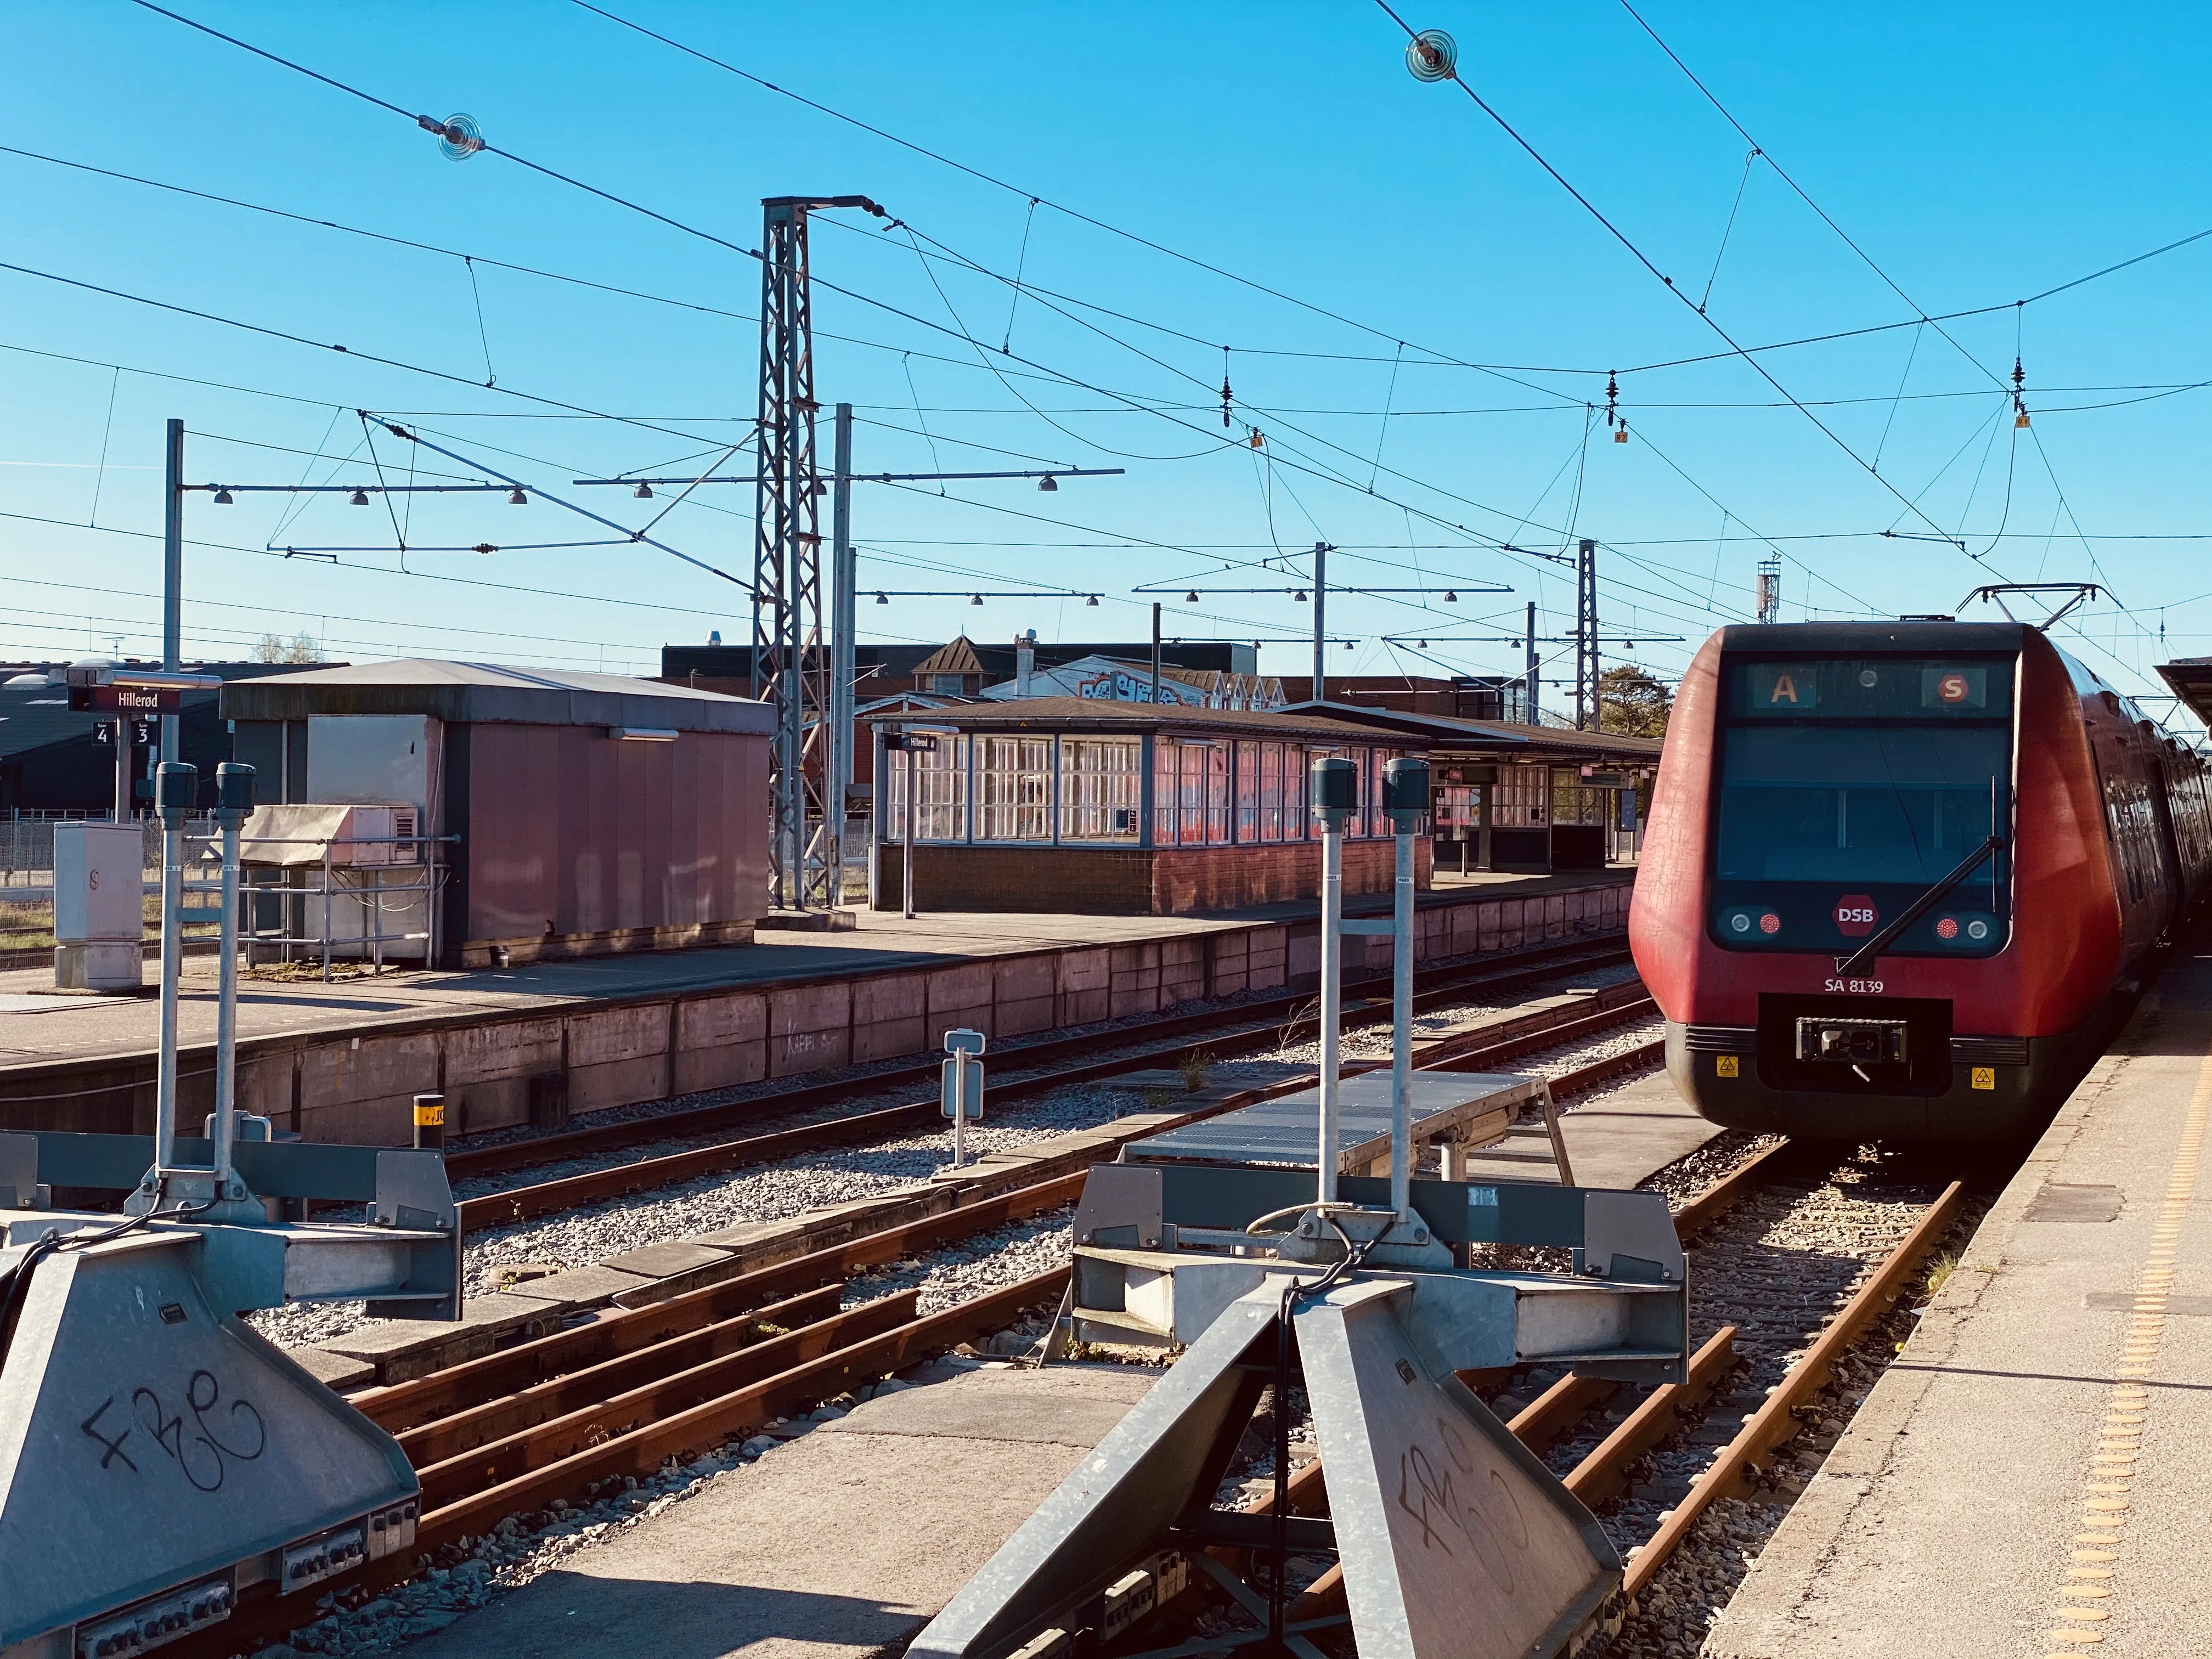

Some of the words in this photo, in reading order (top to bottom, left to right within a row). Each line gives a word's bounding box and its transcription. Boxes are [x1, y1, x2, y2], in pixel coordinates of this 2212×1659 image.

[1771, 675, 1797, 703] A
[1944, 679, 1962, 698] S
[119, 692, 158, 707] Hillerød
[98, 729, 107, 743] 4
[139, 729, 148, 743] 3
[1839, 909, 1874, 922] DSB
[1825, 979, 1845, 992] SA
[1849, 980, 1884, 994] 8139
